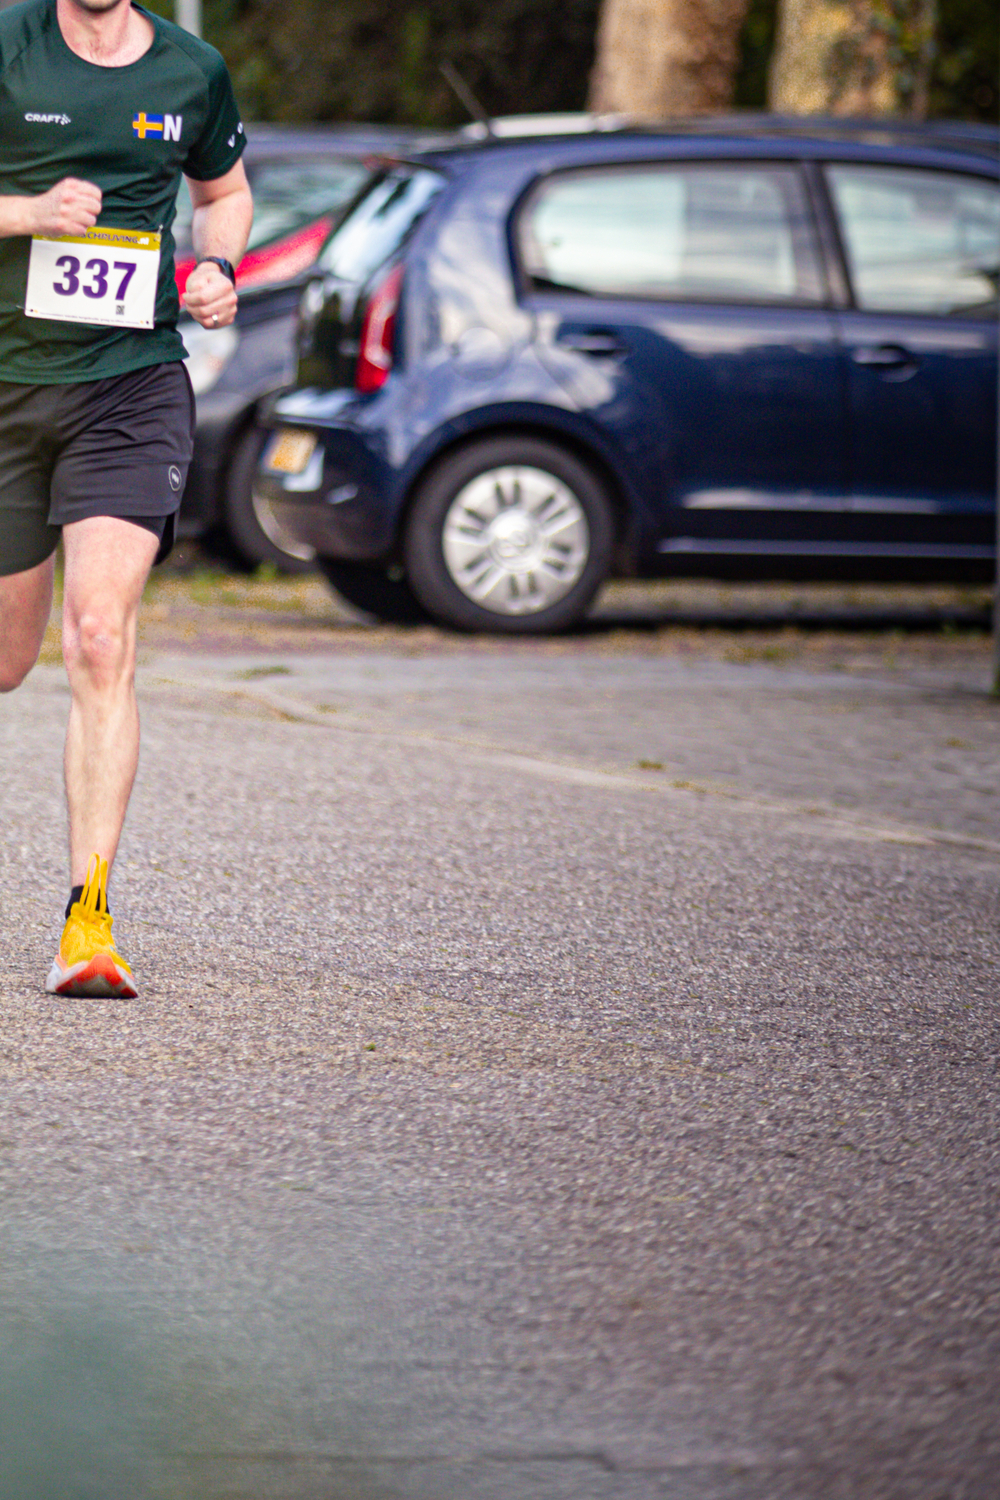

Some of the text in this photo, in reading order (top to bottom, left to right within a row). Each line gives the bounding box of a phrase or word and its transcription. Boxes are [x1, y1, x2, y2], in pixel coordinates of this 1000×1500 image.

[25, 113, 61, 124] CRAFT
[163, 114, 182, 142] N
[52, 255, 137, 301] 337
